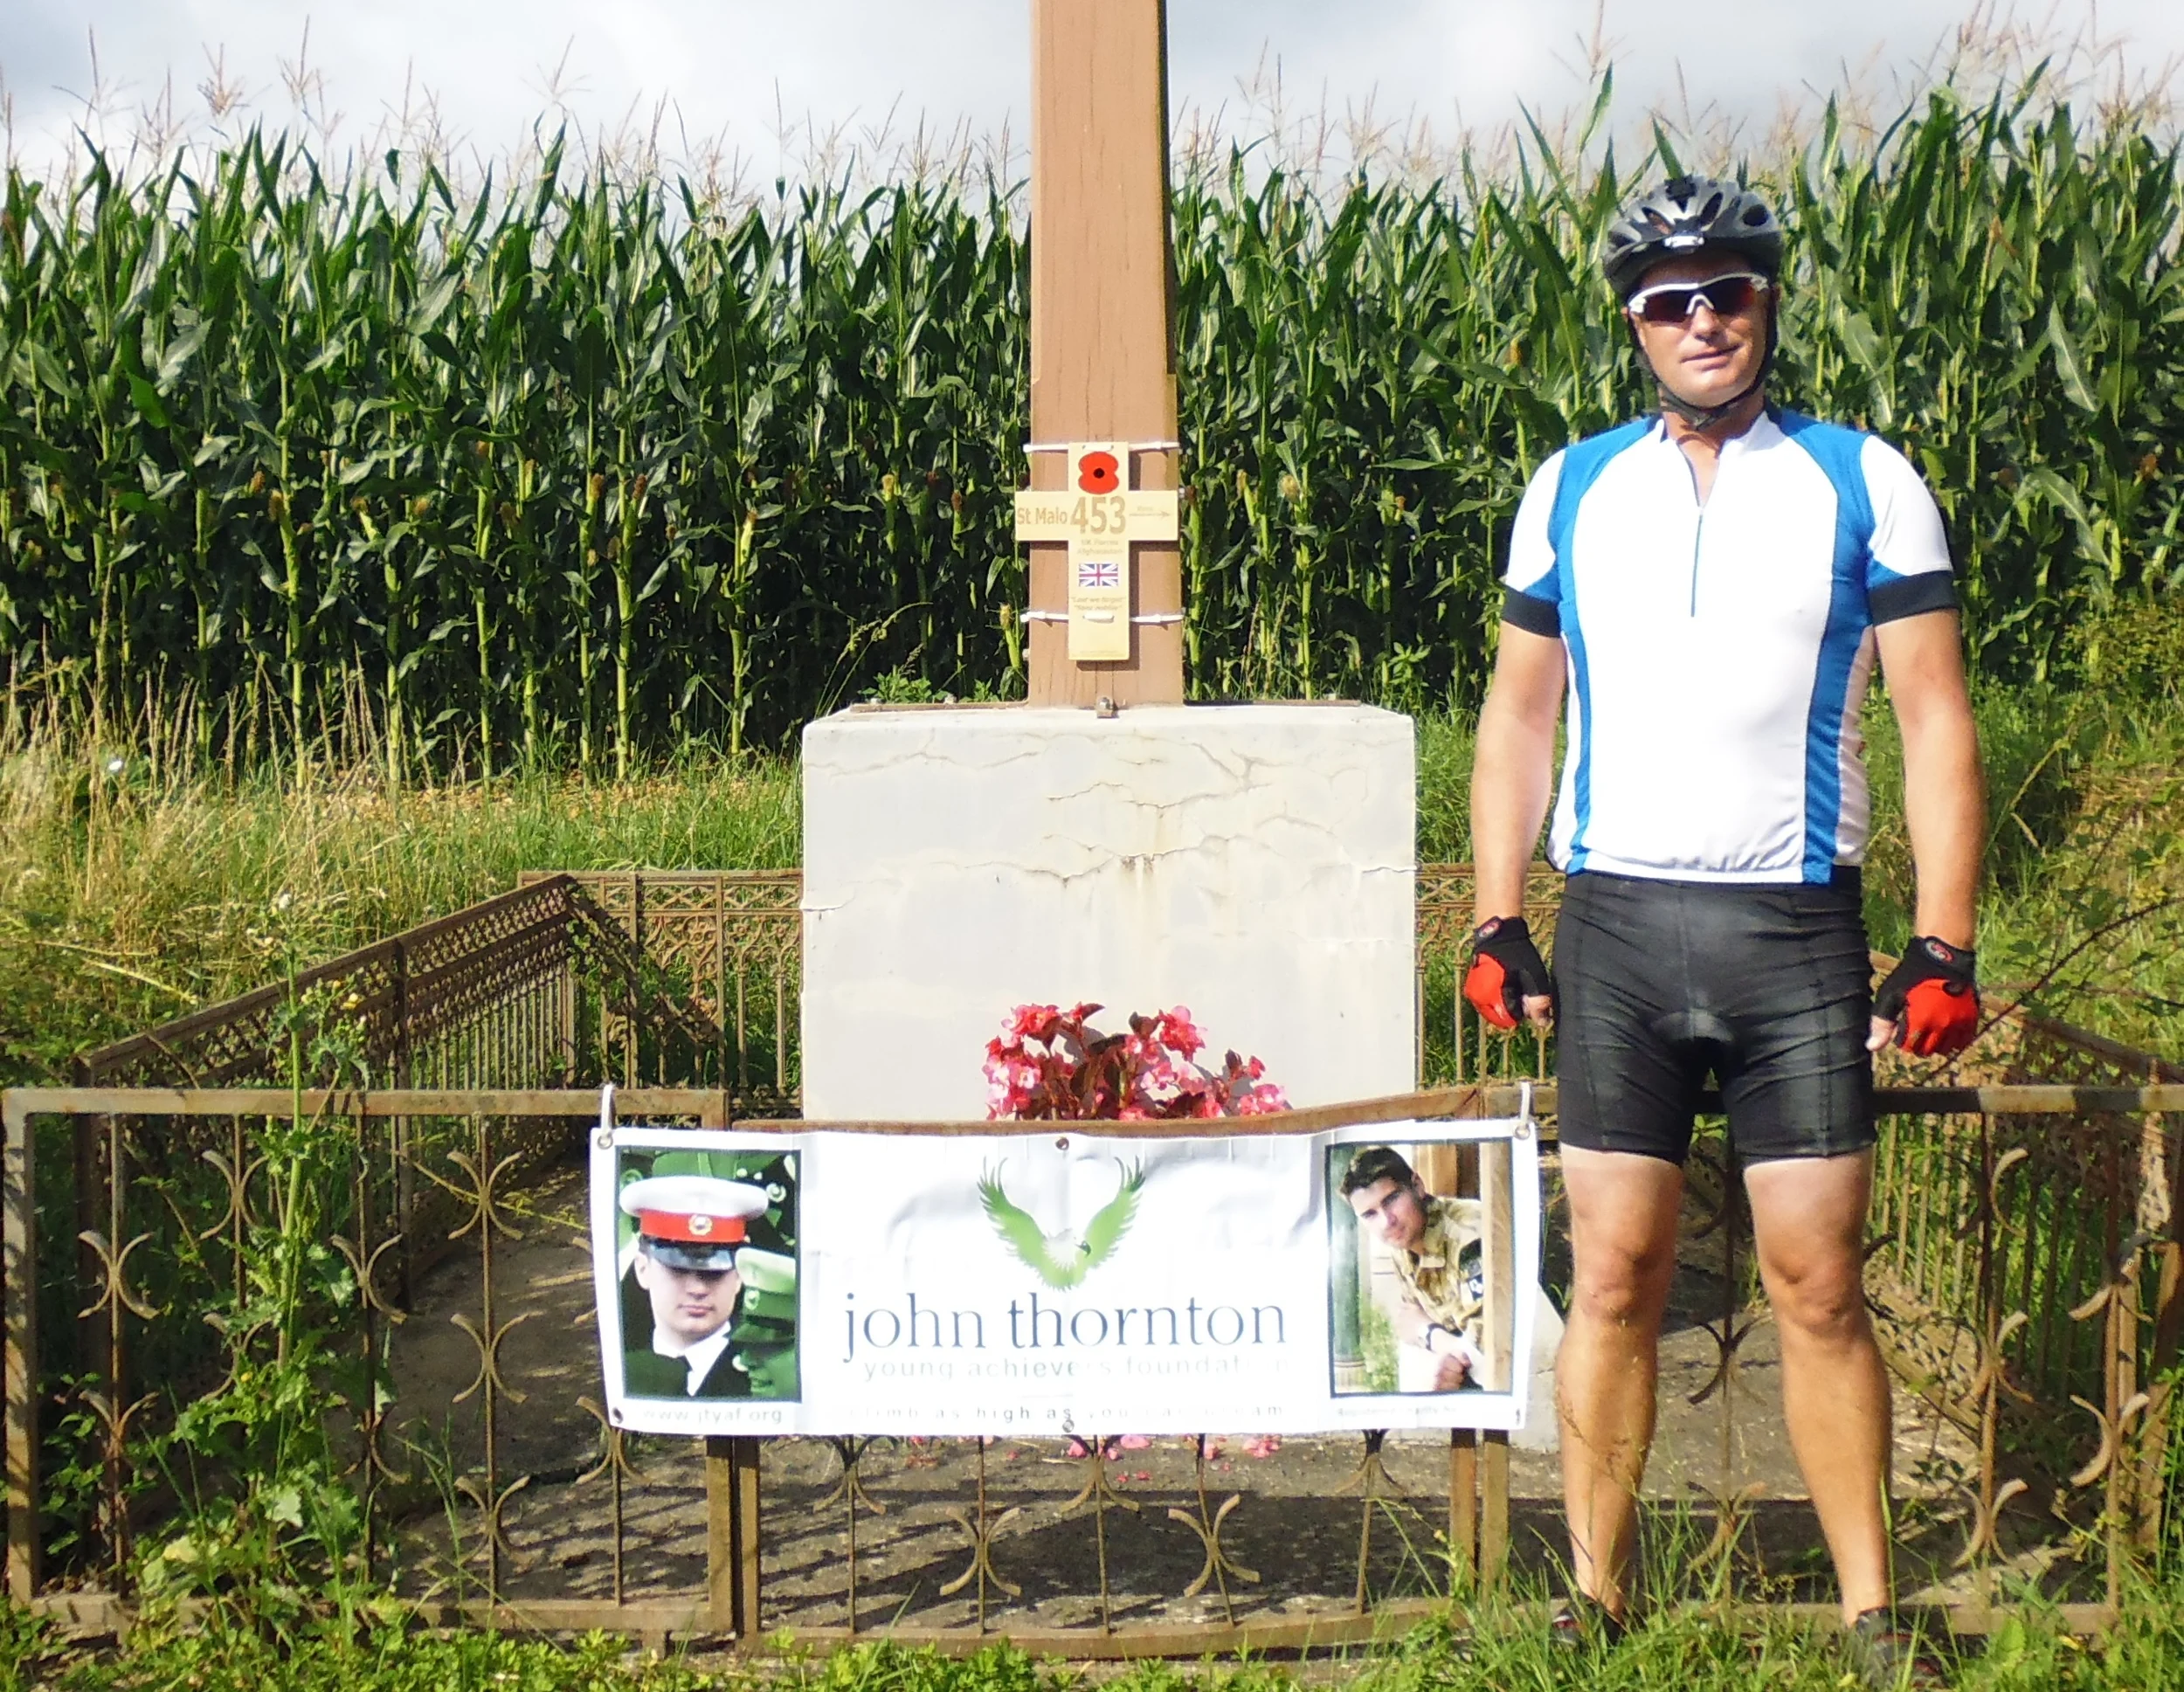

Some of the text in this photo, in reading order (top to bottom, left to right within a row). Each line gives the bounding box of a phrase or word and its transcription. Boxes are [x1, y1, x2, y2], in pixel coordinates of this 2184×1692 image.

[1016, 495, 1126, 535] St Malo 453
[843, 1291, 1288, 1364] john thornton
[864, 1354, 1289, 1384] young achieves foundatn
[643, 1406, 783, 1425] wwwjtyaforg
[936, 1408, 960, 1419] as
[977, 1405, 1031, 1424] high
[1047, 1406, 1072, 1419] as
